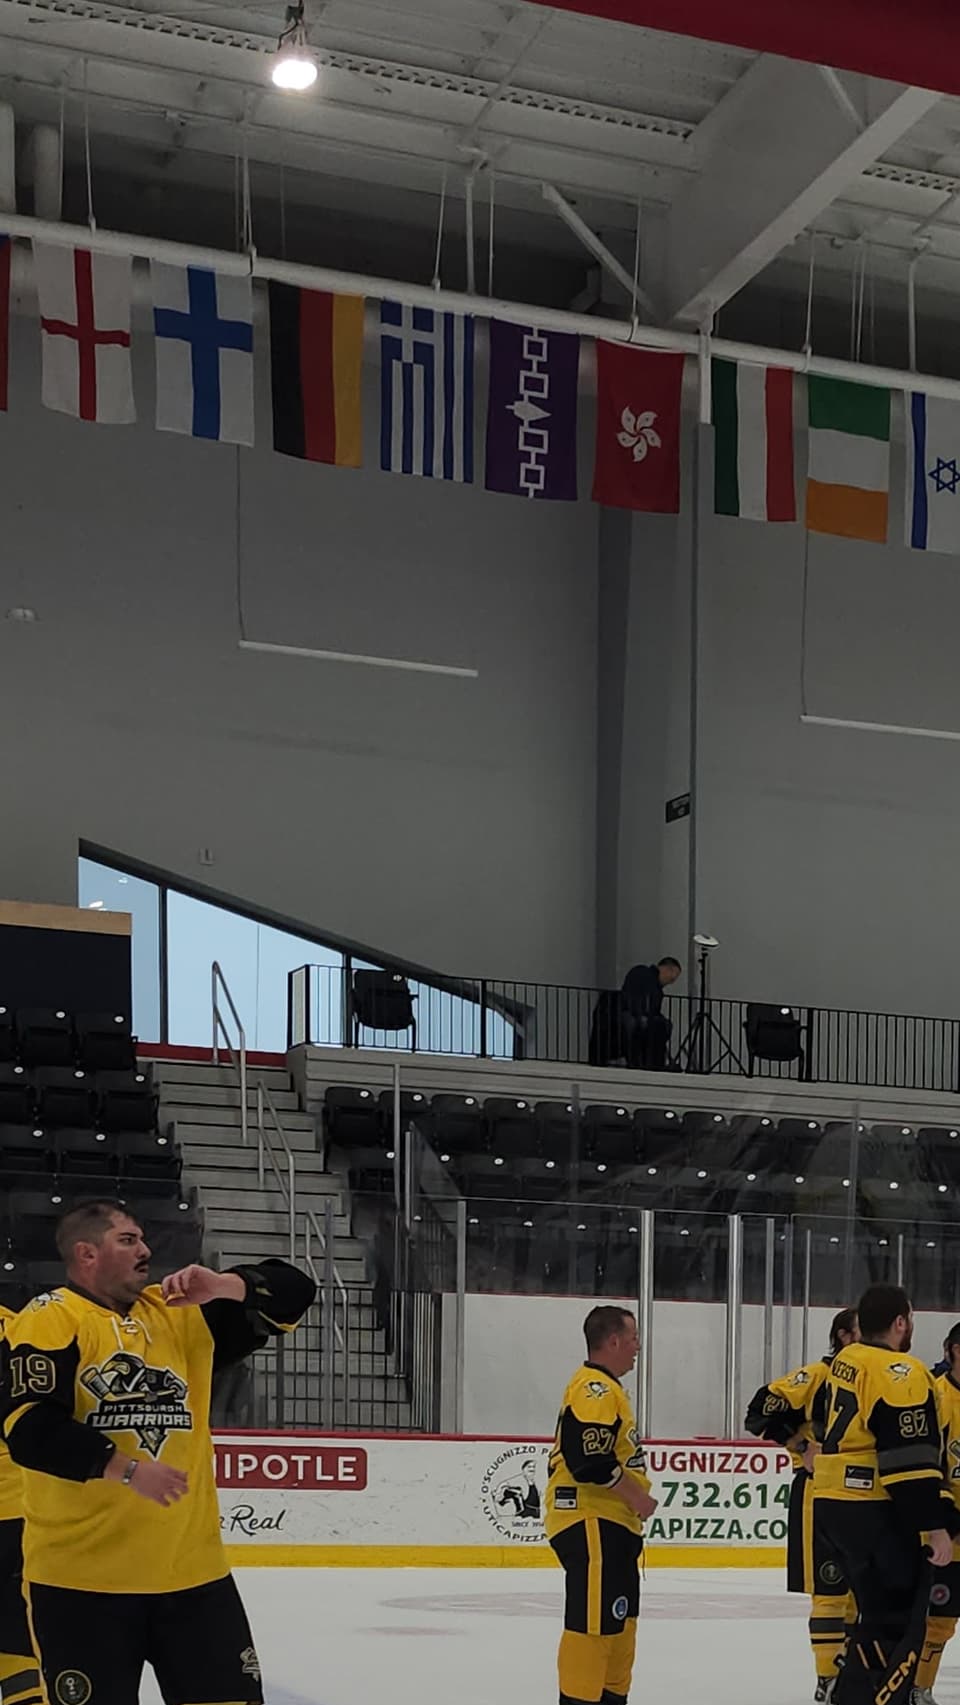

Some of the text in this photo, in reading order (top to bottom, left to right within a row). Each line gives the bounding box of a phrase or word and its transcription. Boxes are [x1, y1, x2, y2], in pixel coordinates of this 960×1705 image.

[10, 1353, 56, 1398] 19
[91, 1414, 191, 1428] WARRIORS
[824, 1386, 859, 1454] 7
[898, 1408, 929, 1439] 97
[582, 1427, 614, 1456] 27
[644, 1451, 768, 1473] UGNIZZO
[230, 1504, 286, 1536] Real
[643, 1518, 787, 1540] APIZZA.CO
